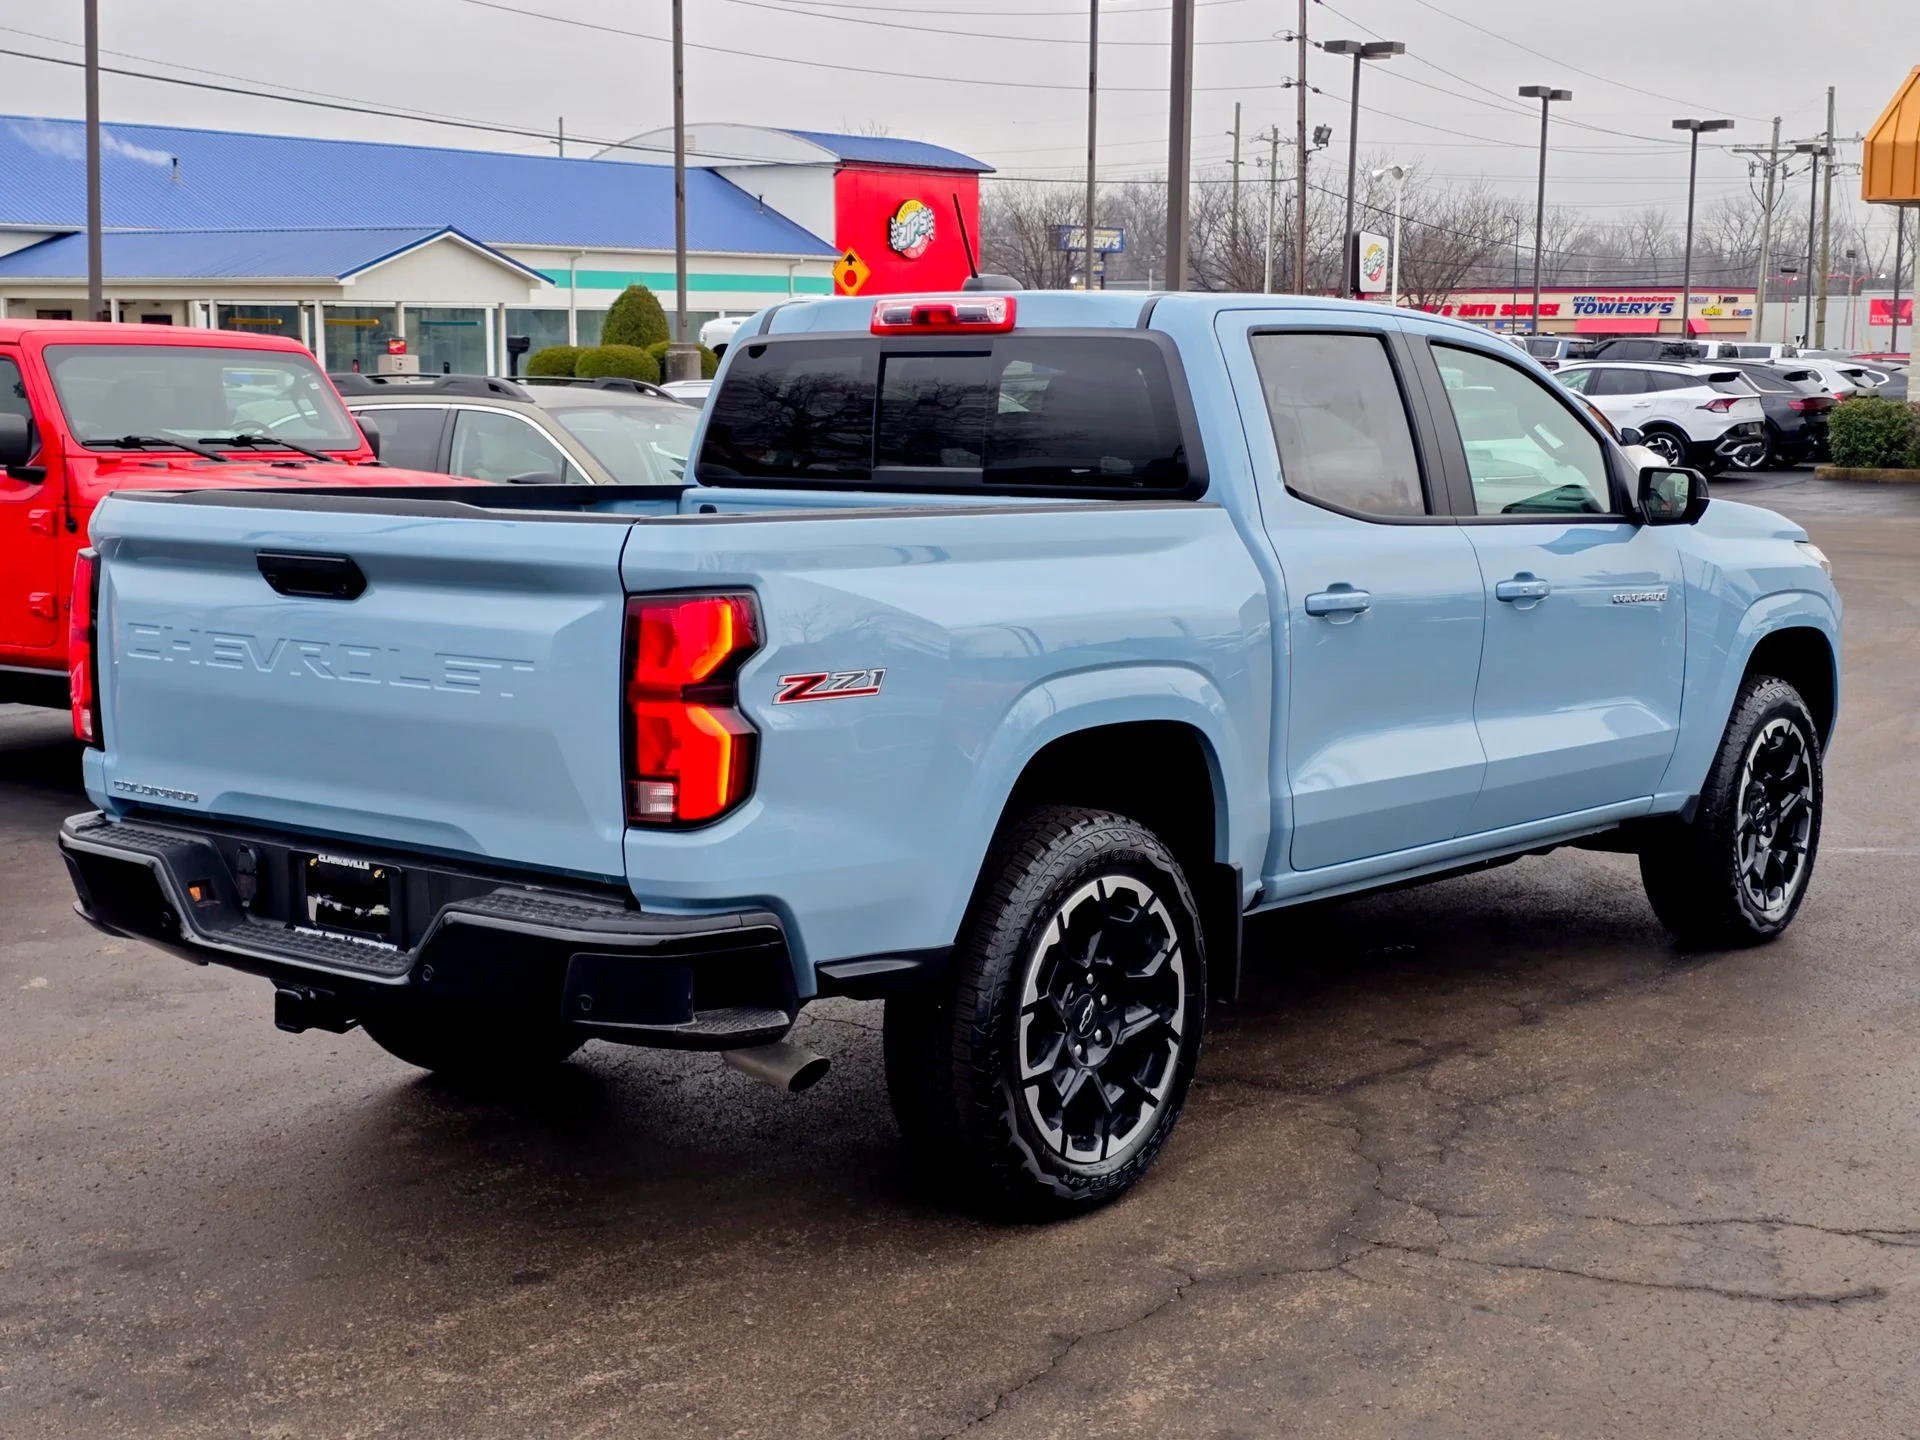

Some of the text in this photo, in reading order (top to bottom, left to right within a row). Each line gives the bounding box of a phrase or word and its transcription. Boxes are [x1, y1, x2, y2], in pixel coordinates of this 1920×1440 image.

[898, 210, 928, 247] ZIPS
[1573, 302, 1674, 314] TOWERY'S
[128, 622, 535, 697] CHEVROLET
[772, 668, 887, 705] Z71
[114, 779, 199, 802] COLORADO
[318, 854, 369, 870] CLARKSVILLE
